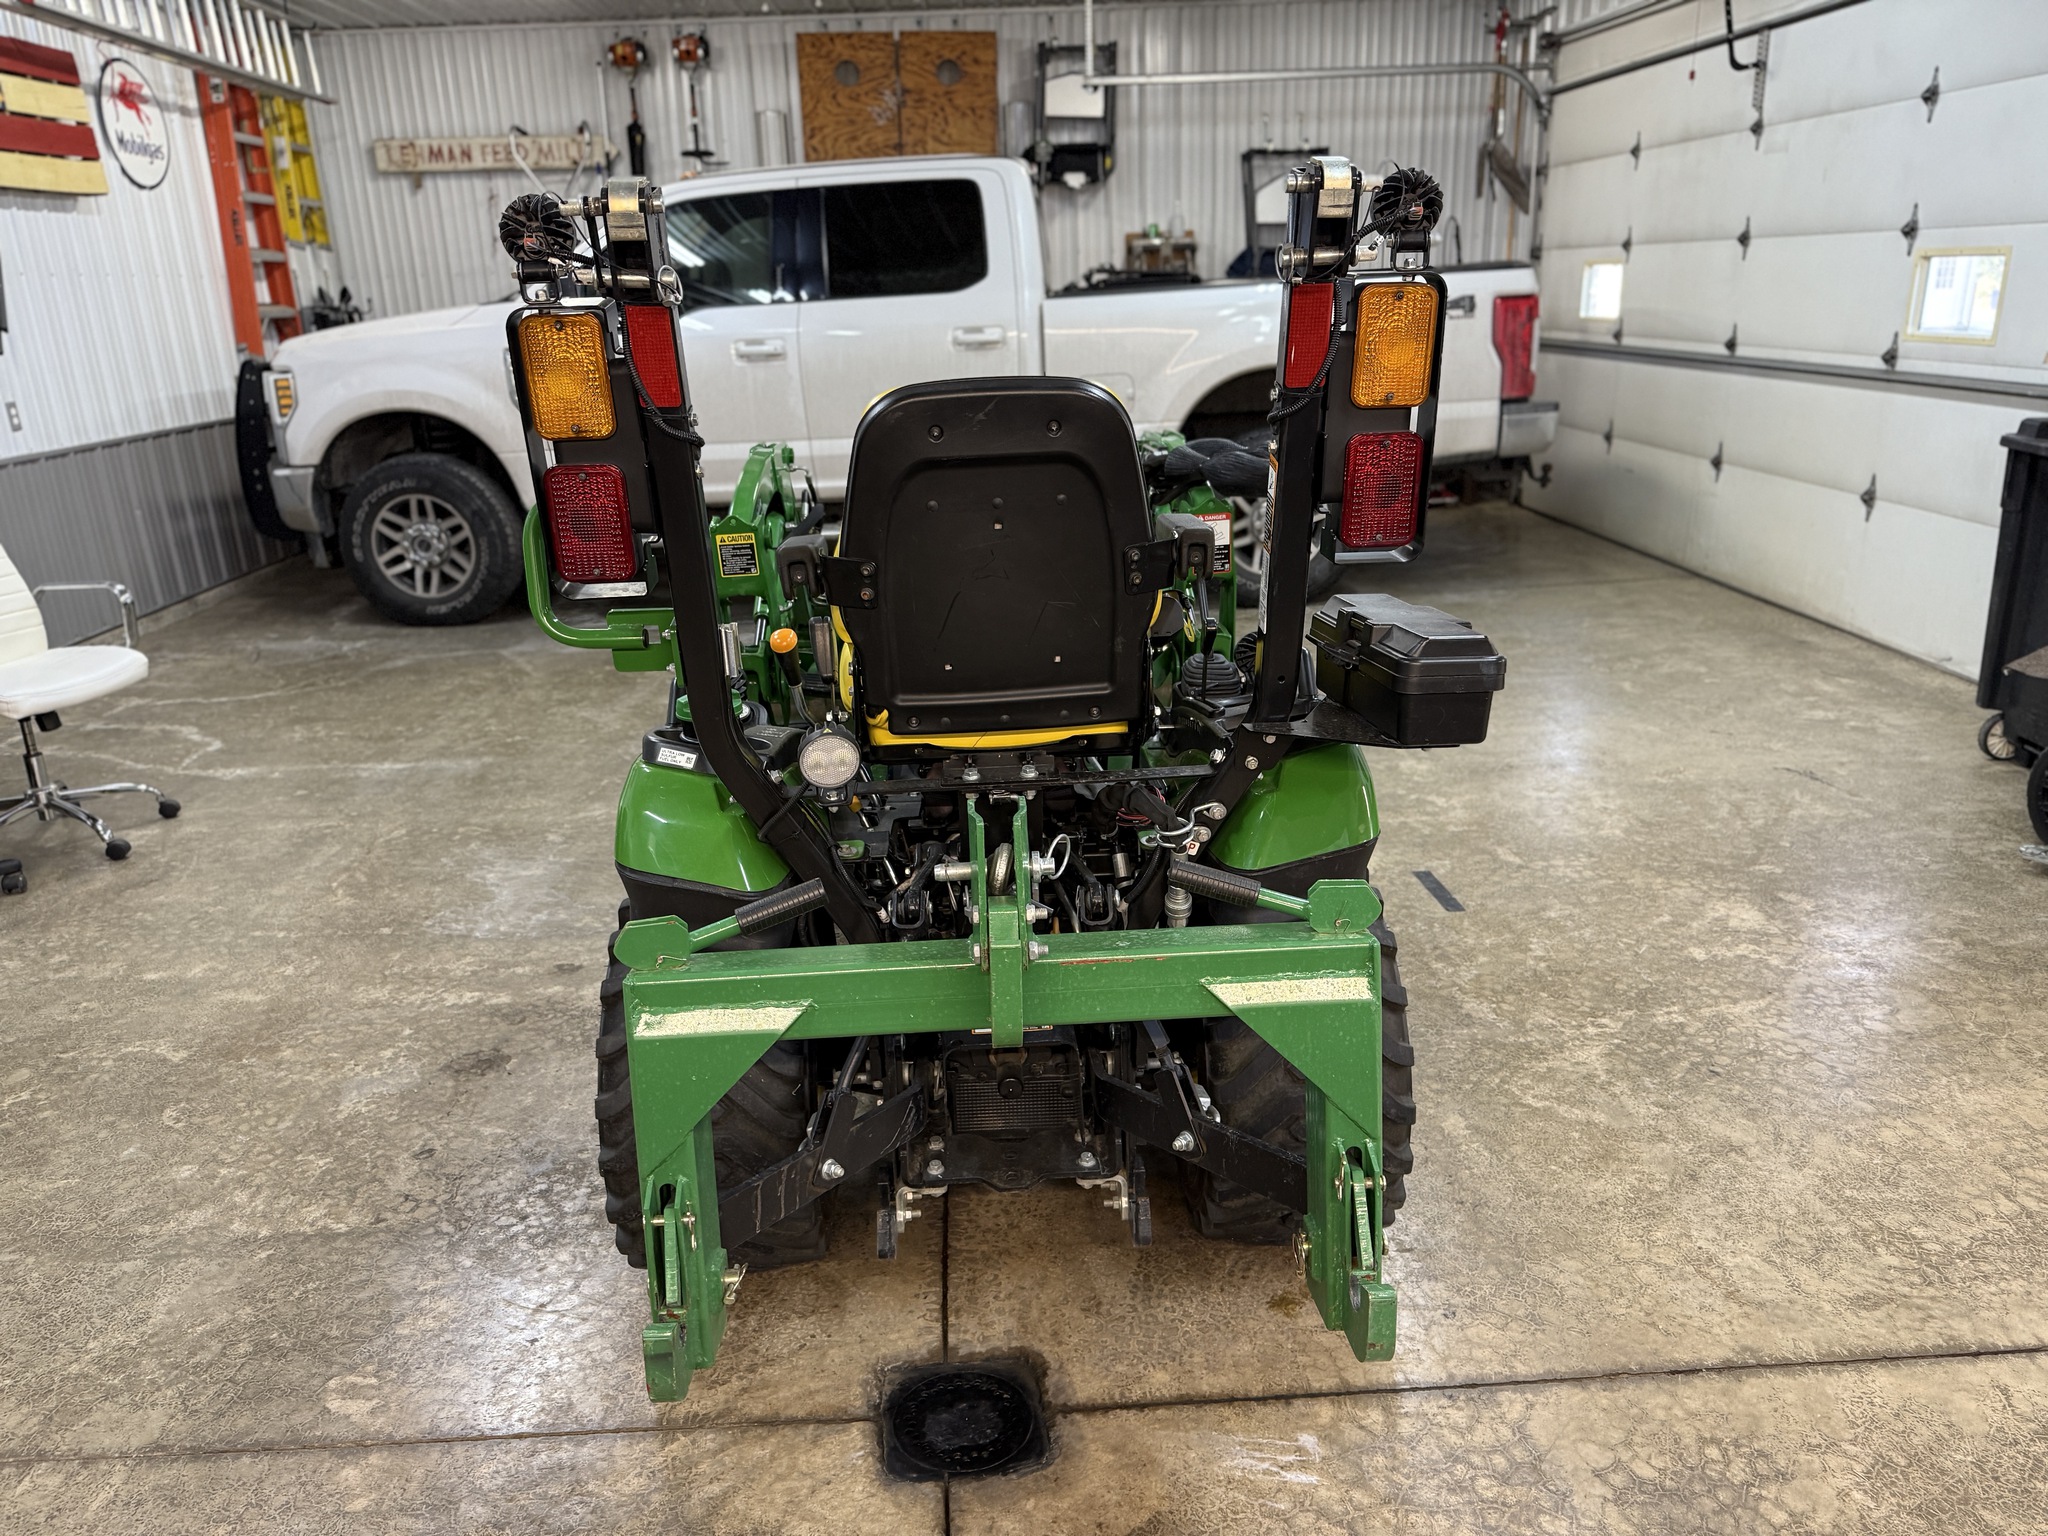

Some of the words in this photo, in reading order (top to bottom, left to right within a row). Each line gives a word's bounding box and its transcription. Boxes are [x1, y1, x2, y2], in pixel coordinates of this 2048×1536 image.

[115, 129, 165, 164] Mobilgas
[385, 142, 472, 167] LEHMAN
[480, 142, 529, 164] FEED
[726, 534, 753, 543] CAUTION
[1188, 842, 1196, 852] P
